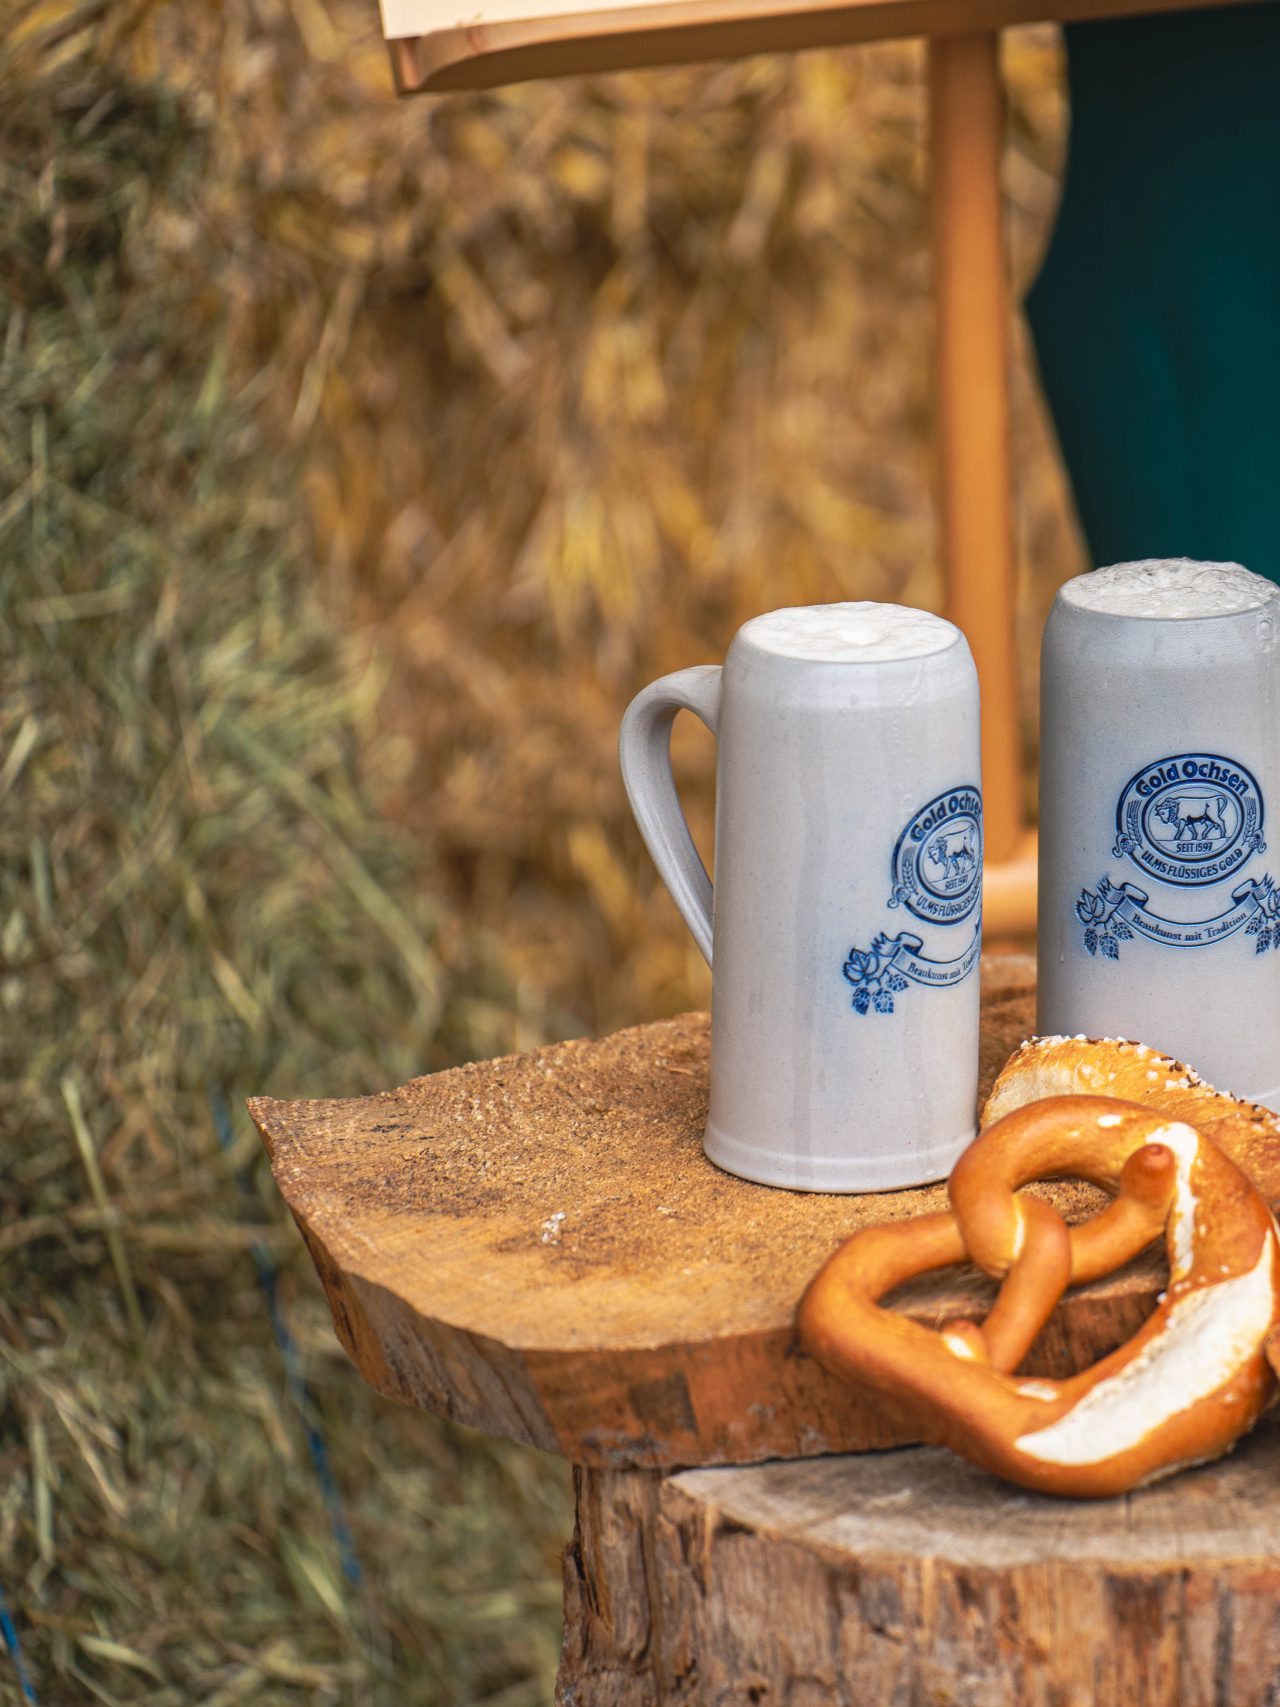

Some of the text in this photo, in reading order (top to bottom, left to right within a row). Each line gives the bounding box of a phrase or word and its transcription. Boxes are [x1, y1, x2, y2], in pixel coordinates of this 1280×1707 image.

[1135, 760, 1250, 798] Gold Ochsen
[910, 801, 947, 843] Gold
[1176, 841, 1212, 854] SEIT 1597
[1141, 848, 1244, 880] ULMS FLÜSSIGES GOLD
[917, 895, 939, 914] ULMS
[1131, 911, 1248, 942] Braukunst mit Tradition
